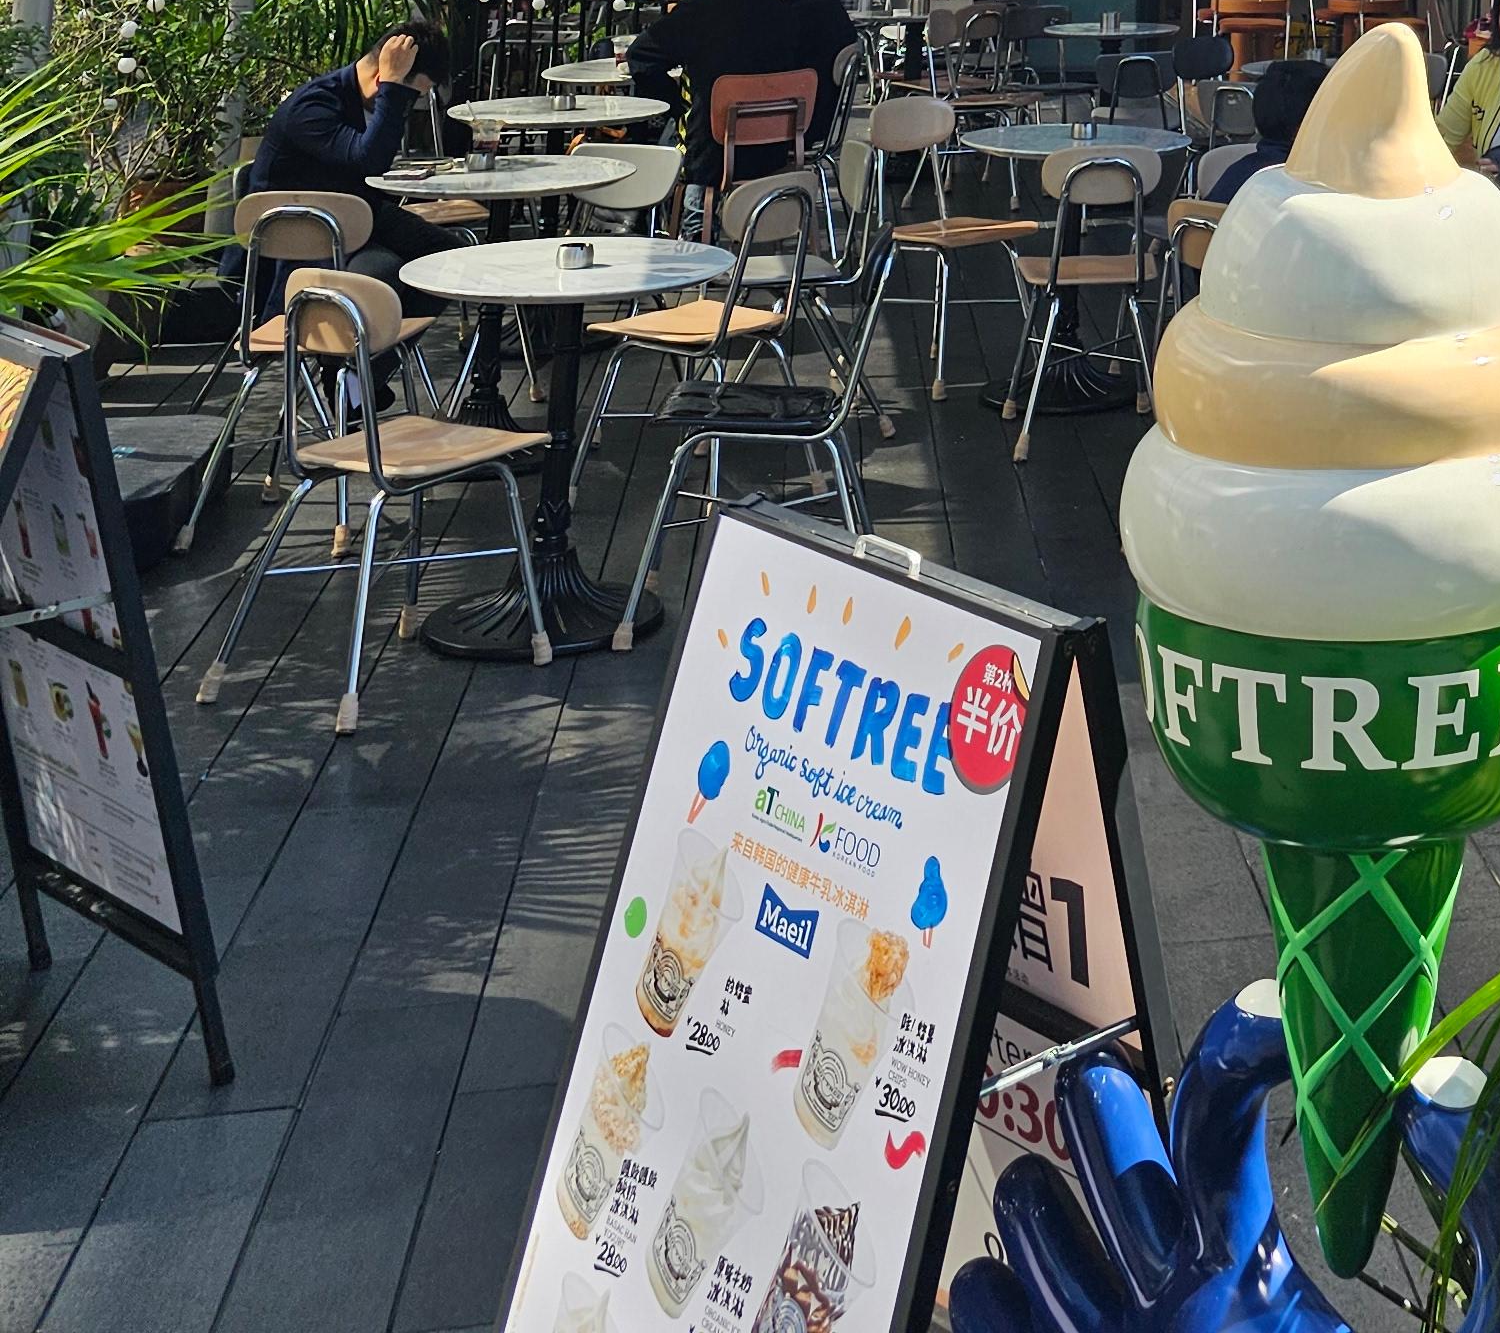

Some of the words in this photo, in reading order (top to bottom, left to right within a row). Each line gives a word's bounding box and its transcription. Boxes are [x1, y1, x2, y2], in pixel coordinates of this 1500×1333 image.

[729, 617, 951, 796] SOFTREE
[957, 686, 1023, 762] 半价
[774, 803, 806, 833] CHINA
[835, 826, 881, 868] FOOD
[730, 832, 870, 921] 来自韩国的健康牛乳冰淇淋
[760, 899, 811, 950] Maeil
